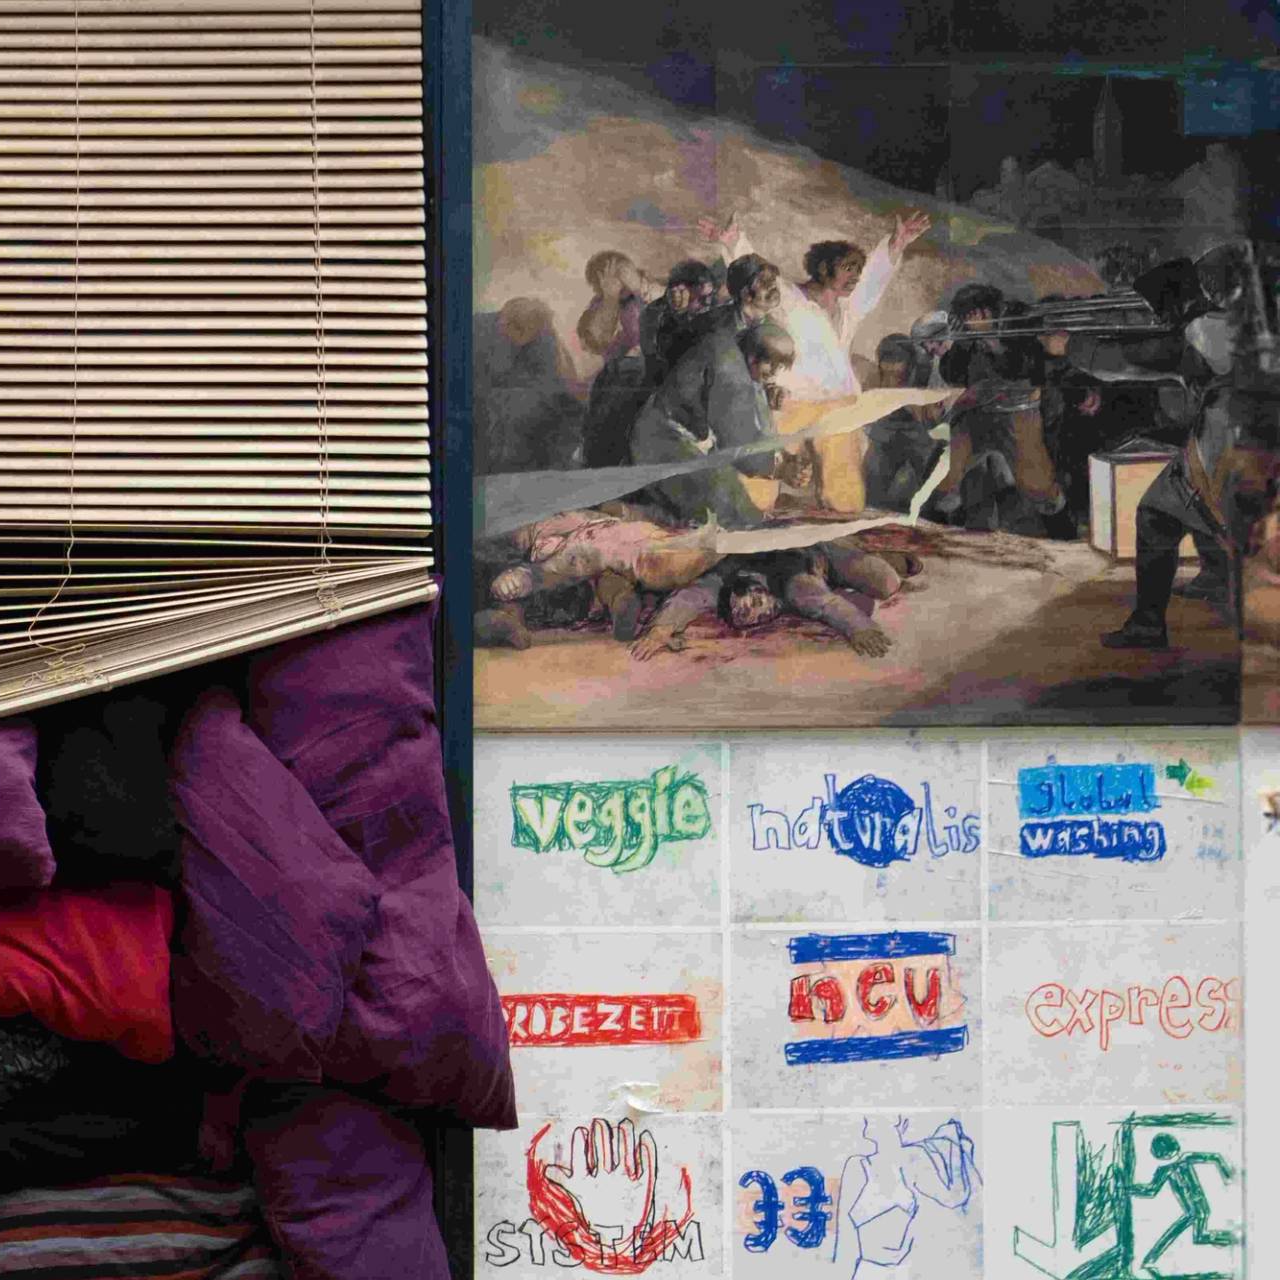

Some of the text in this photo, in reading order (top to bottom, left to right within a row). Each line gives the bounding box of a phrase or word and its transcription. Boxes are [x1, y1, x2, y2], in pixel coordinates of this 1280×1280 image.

[514, 765, 711, 874] veggie
[1022, 815, 1162, 859] washing
[500, 1001, 686, 1037] ROBEZEIT
[485, 1218, 705, 1268] SYSTEM
